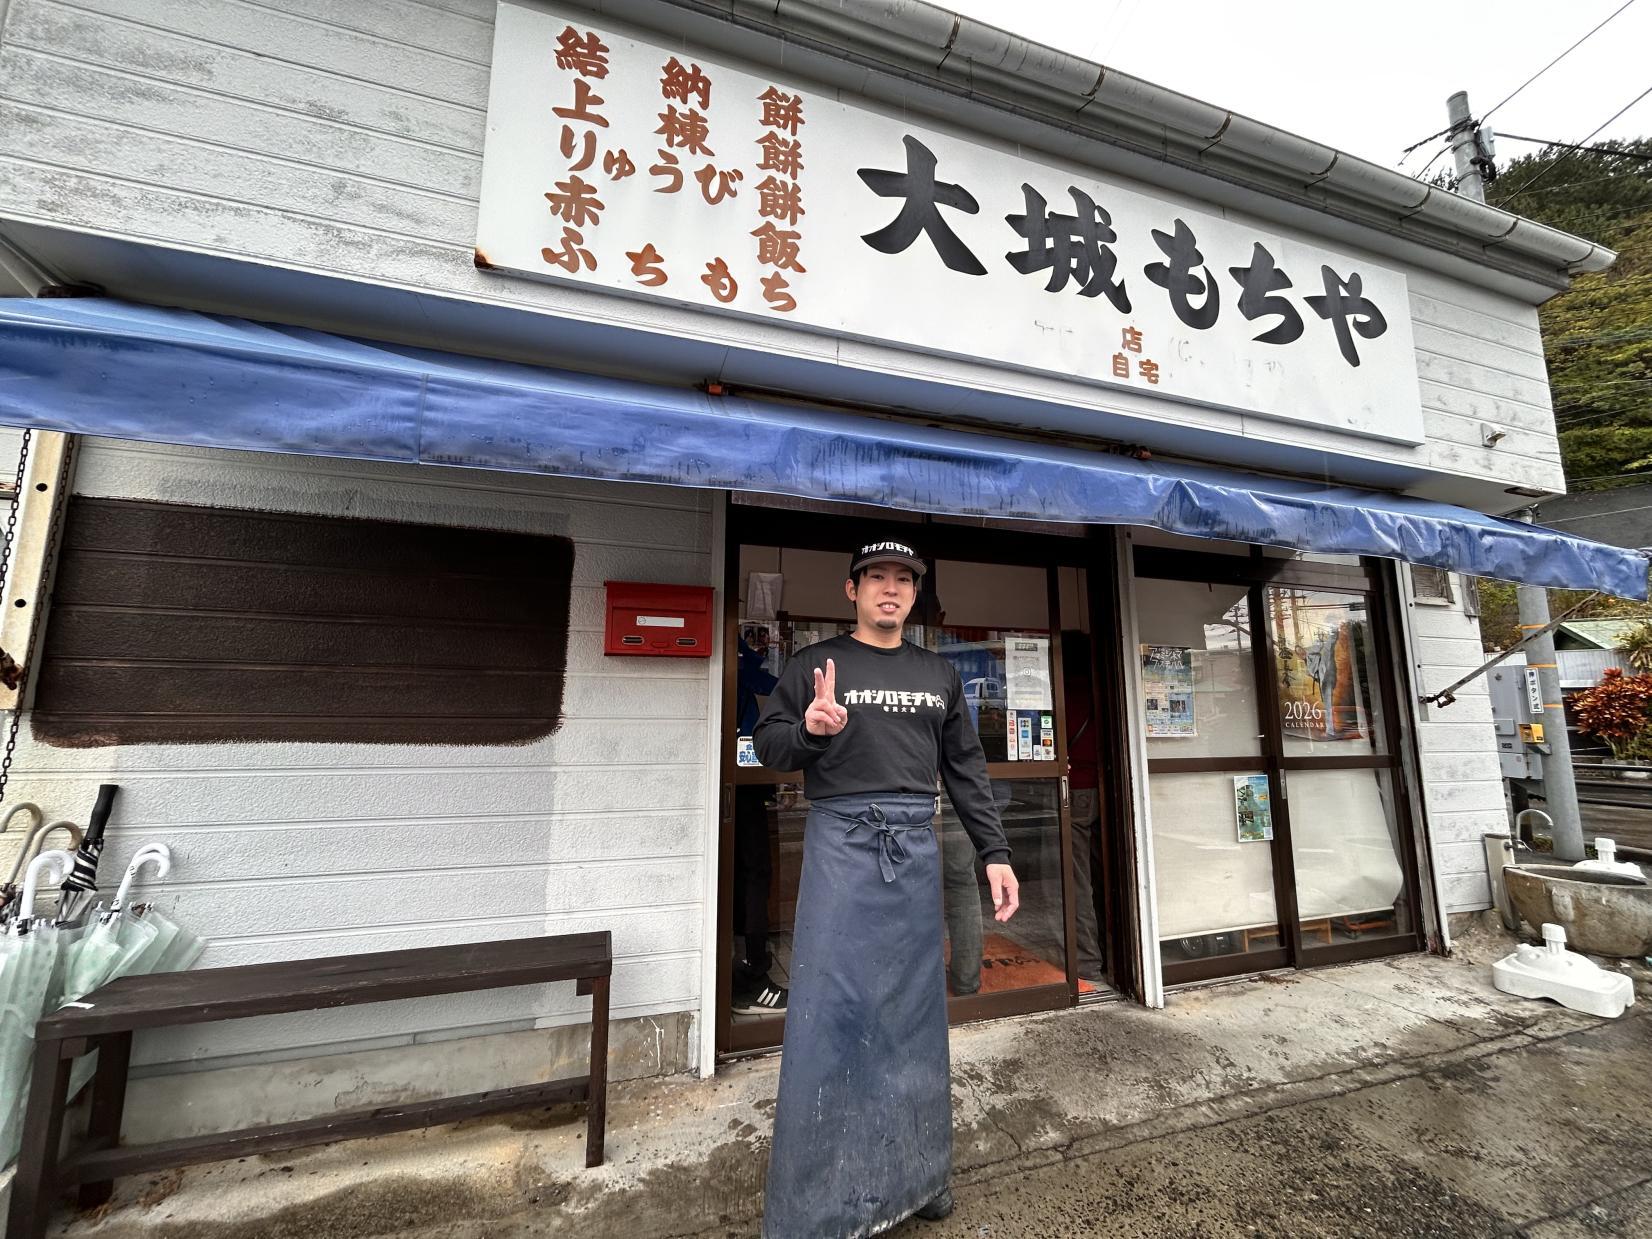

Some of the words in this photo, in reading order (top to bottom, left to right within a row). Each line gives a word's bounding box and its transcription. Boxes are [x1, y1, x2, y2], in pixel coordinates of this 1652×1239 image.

[553, 26, 806, 136] 結納餅
[552, 78, 805, 181] 上棟餅
[559, 125, 806, 226] りゅうび餅
[541, 226, 797, 312] ふちもち
[544, 175, 807, 273] 赤飯
[857, 134, 1388, 368] 大城もちや
[1112, 352, 1159, 385] 自宅
[1121, 326, 1143, 354] 店
[844, 690, 936, 707] オオシロモチヤ
[1284, 701, 1322, 720] 2026
